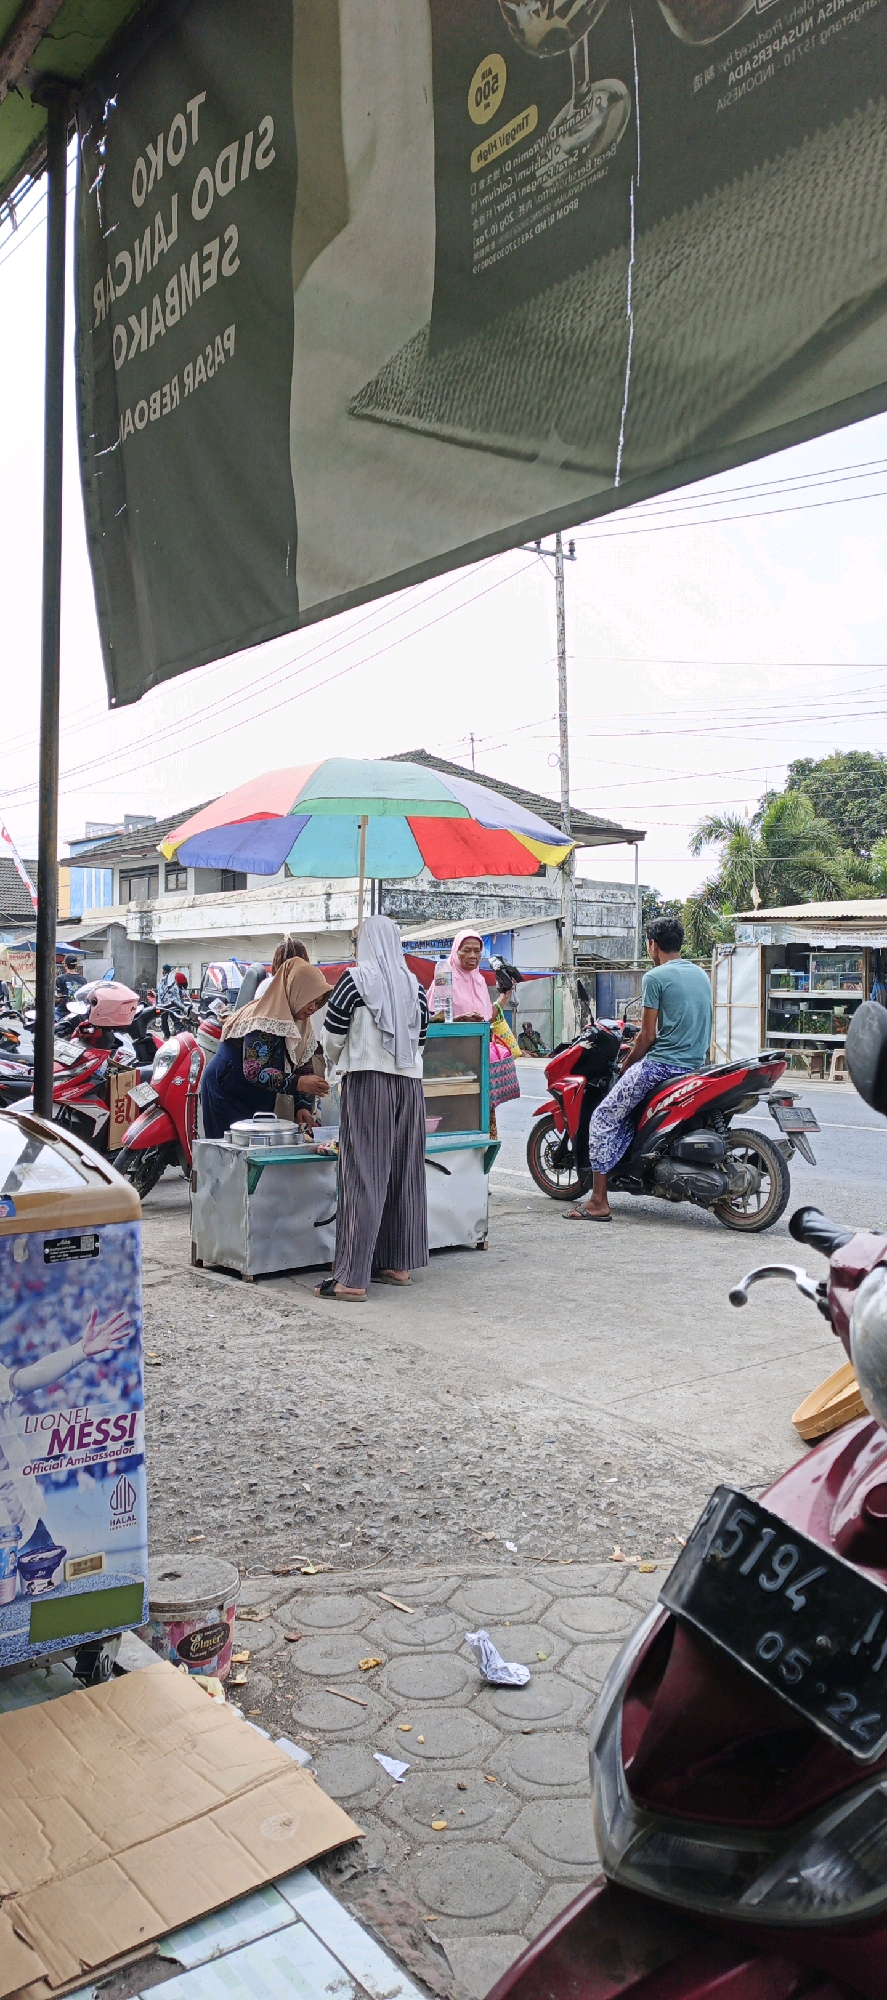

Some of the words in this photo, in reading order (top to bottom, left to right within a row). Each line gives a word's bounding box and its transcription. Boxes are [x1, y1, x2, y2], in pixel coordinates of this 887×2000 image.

[646, 1079, 703, 1120] VARIO
[24, 1408, 92, 1434] LIONEL
[47, 1413, 137, 1456] MESSI
[22, 1458, 63, 1476] Official
[65, 1445, 135, 1468] Ambassador
[110, 1514, 137, 1527] HALAL
[713, 1508, 828, 1612] 5194
